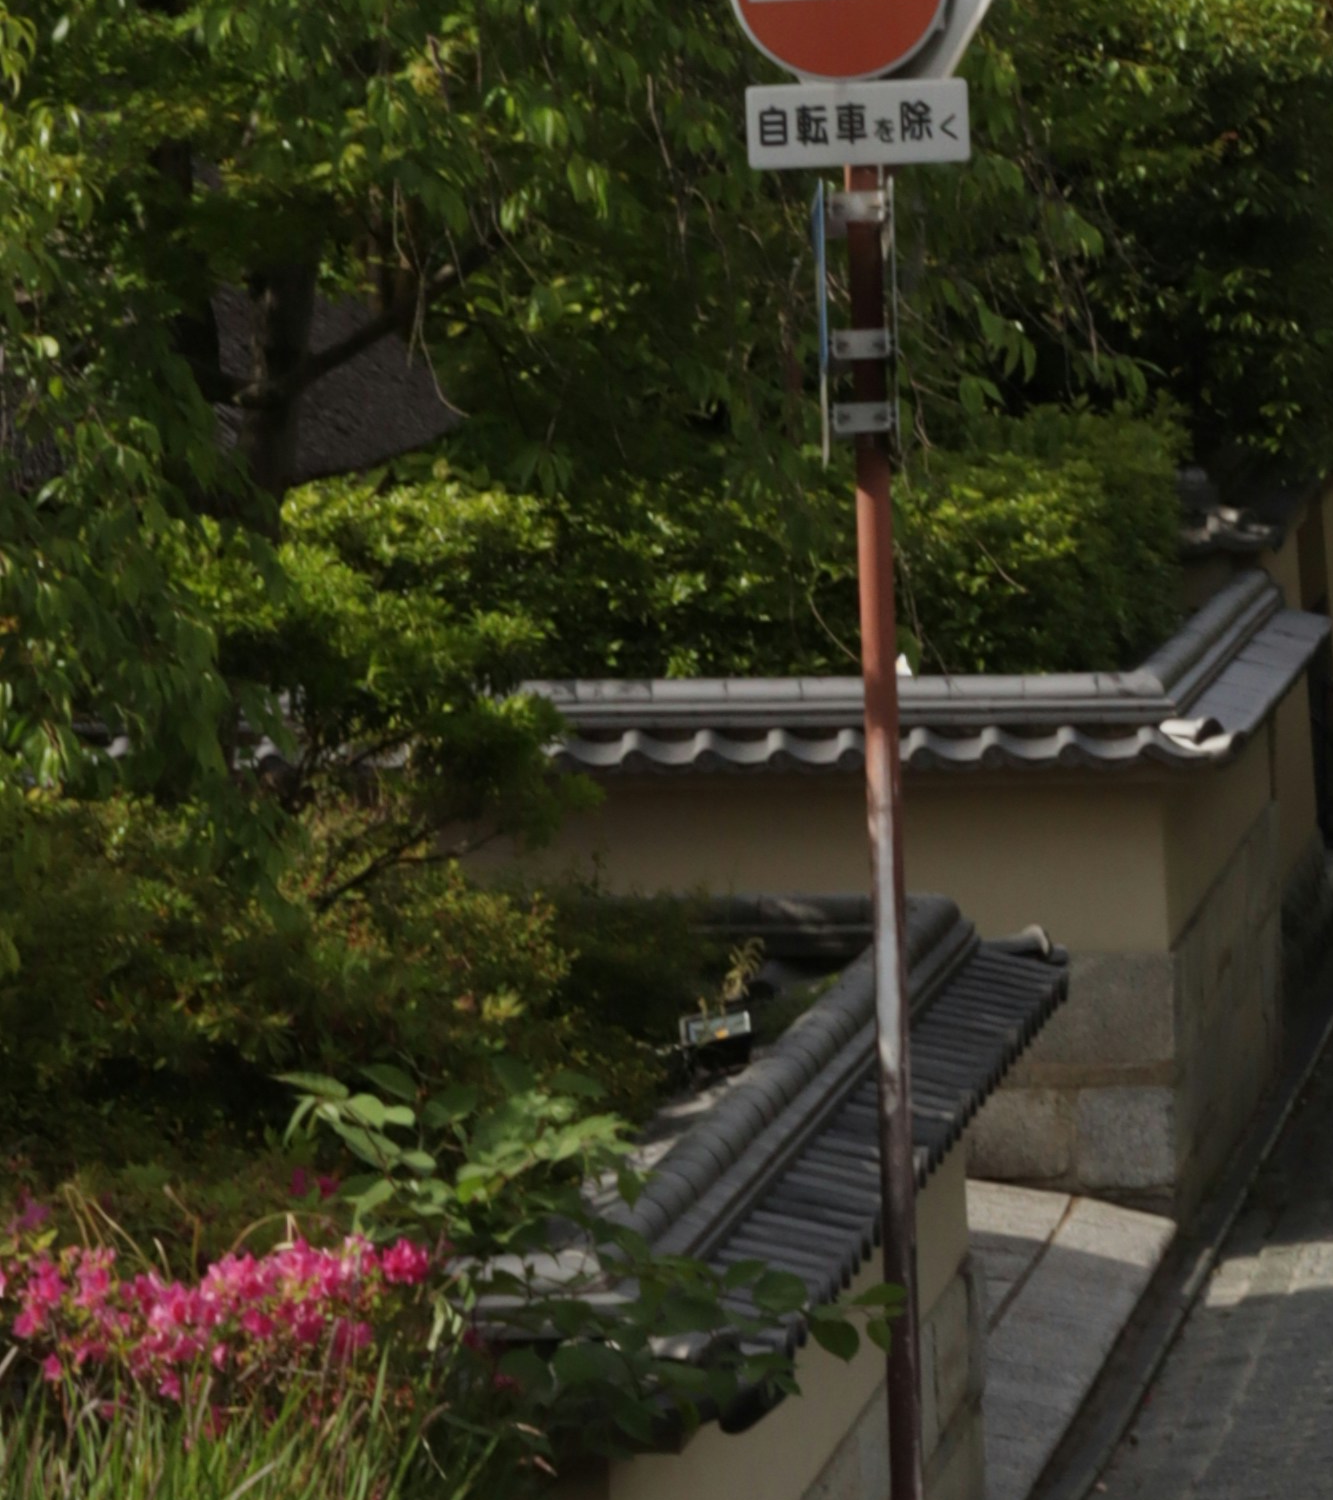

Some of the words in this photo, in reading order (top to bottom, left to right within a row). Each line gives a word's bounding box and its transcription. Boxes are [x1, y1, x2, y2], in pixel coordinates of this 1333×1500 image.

[759, 99, 959, 146] 自転車を除く
